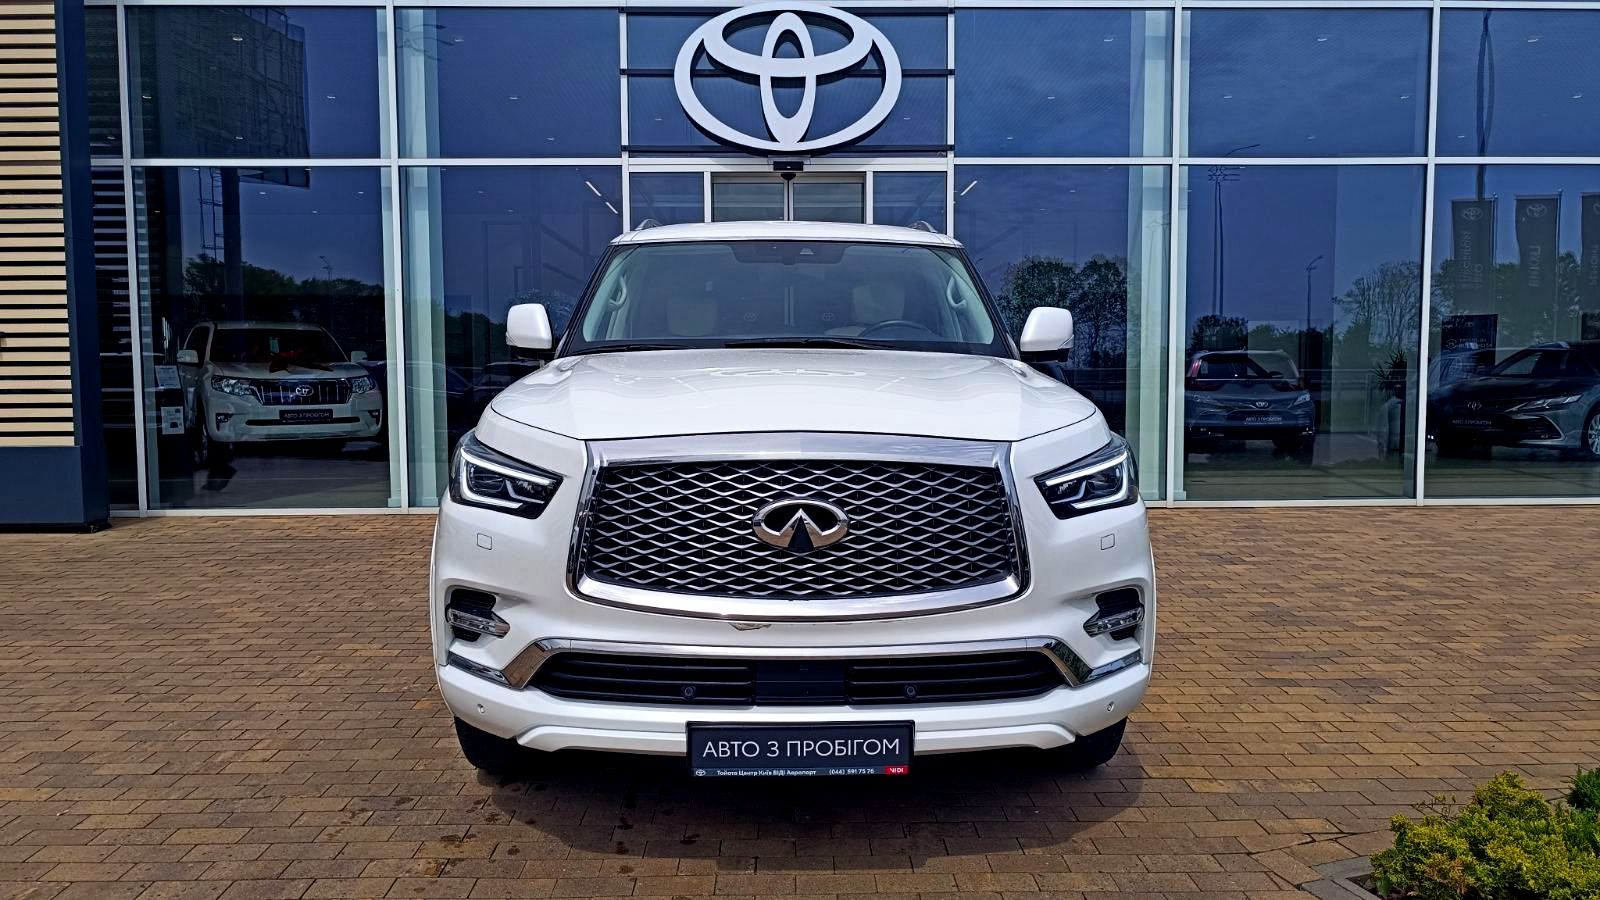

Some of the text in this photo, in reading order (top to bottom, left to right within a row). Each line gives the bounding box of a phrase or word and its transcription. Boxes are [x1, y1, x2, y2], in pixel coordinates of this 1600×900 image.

[703, 738, 900, 758] АВТО З ПРОБІГОМ
[739, 769, 758, 777] Центр
[786, 769, 816, 777] Аеропорт
[828, 768, 846, 776] (044)
